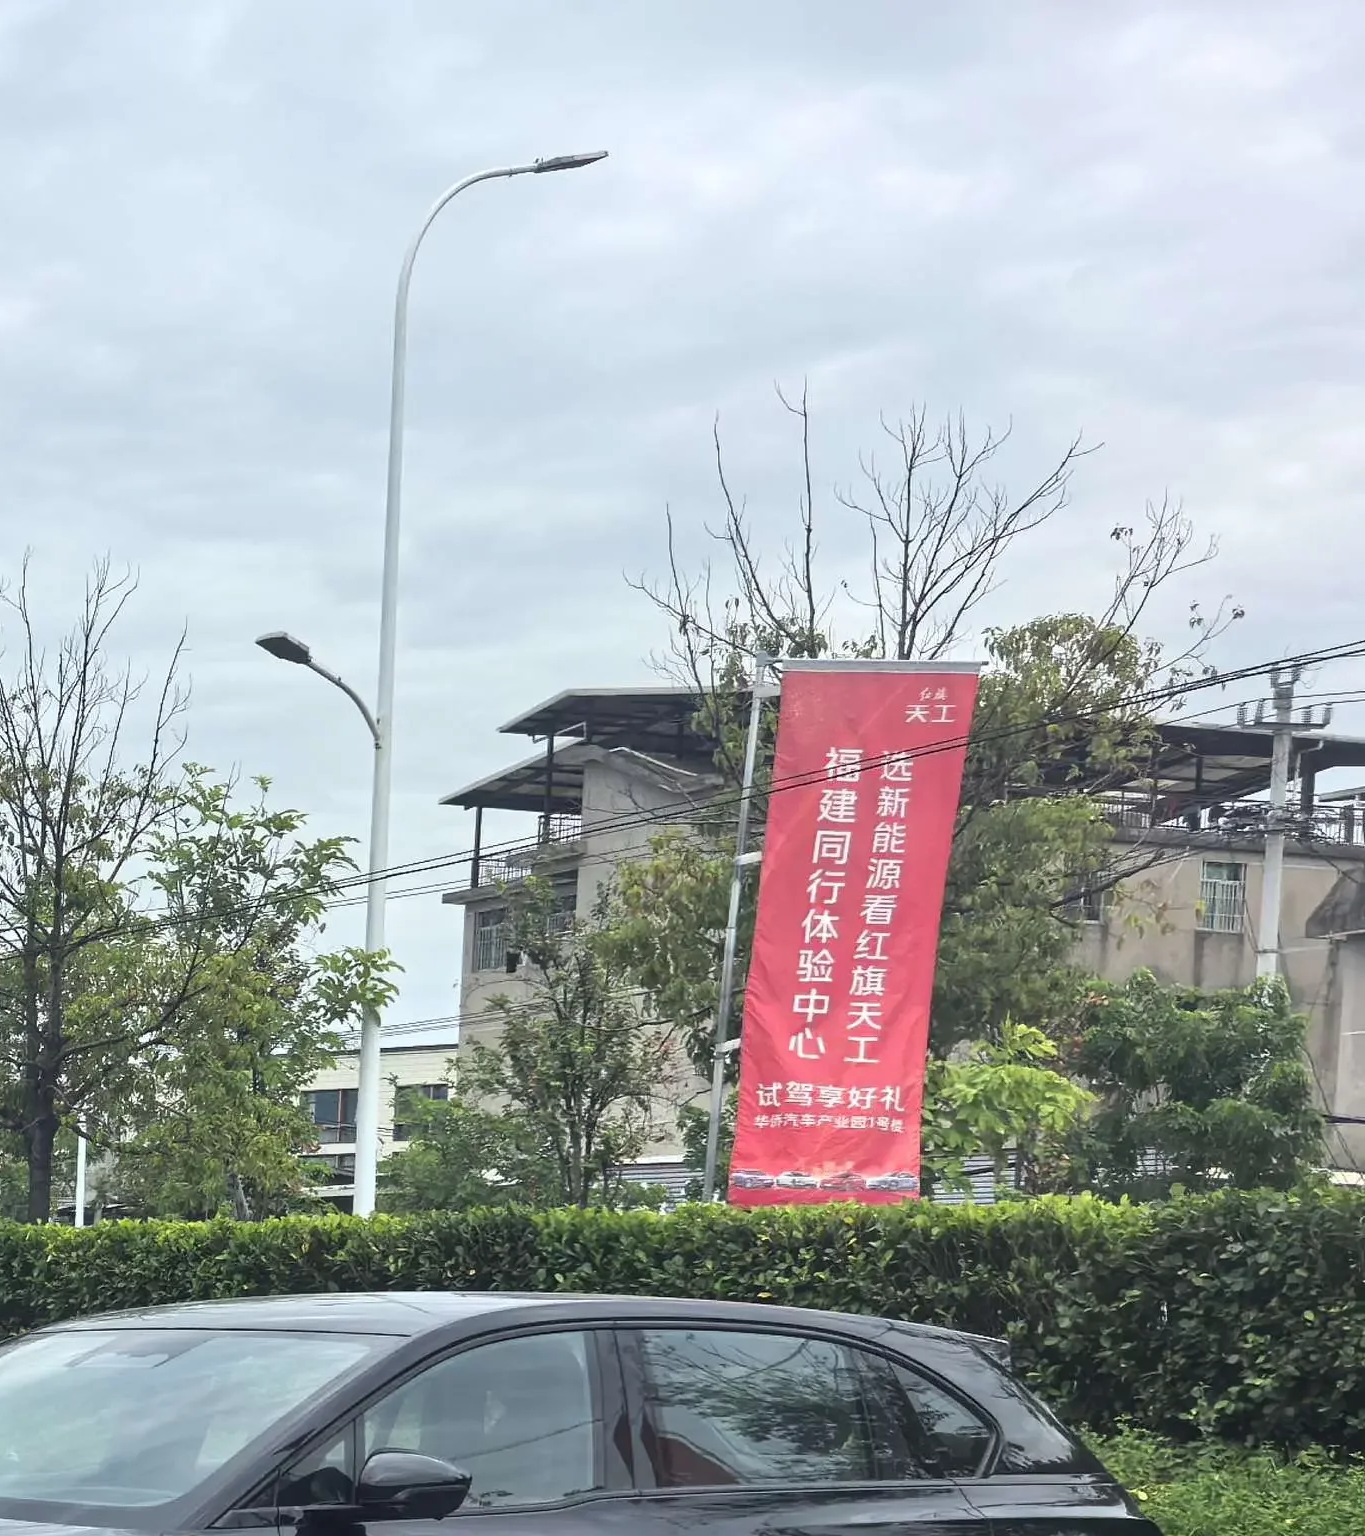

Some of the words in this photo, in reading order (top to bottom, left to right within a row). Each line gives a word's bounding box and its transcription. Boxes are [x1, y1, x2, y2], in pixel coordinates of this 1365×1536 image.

[920, 687, 948, 701] 红旗
[905, 704, 956, 723] 天工
[789, 747, 864, 1061] 福建同行体验中心
[844, 751, 914, 1066] 选新能源看红旗天工
[756, 1081, 904, 1112] 试驾享好礼
